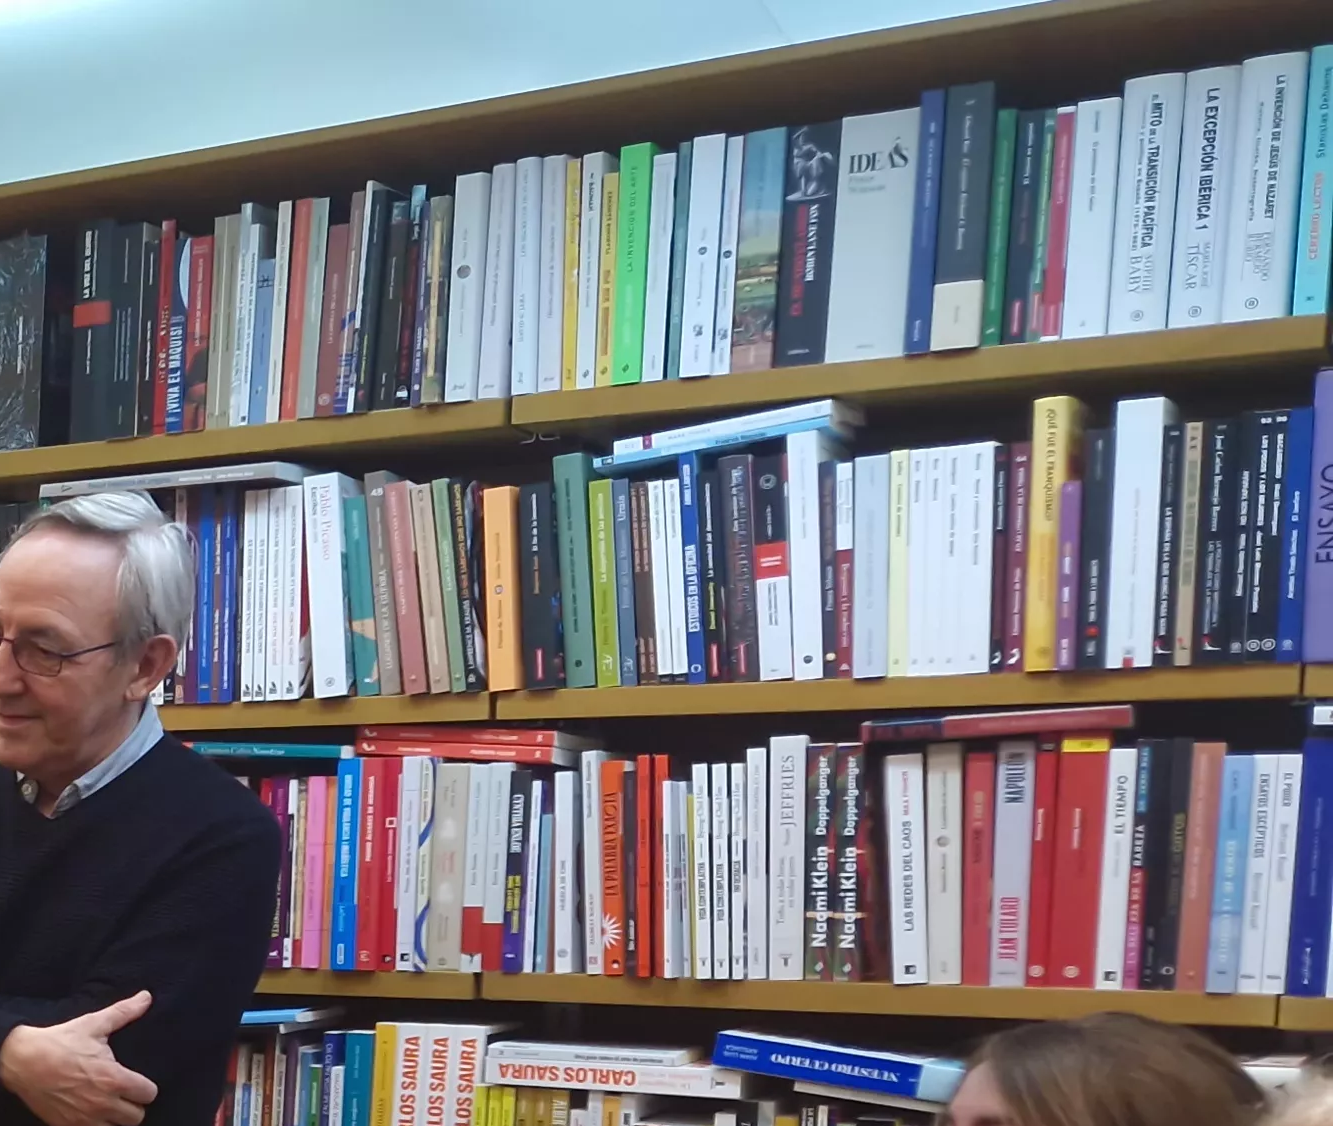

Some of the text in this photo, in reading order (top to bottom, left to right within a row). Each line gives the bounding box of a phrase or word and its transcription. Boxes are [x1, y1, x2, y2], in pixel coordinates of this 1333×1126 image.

[1205, 88, 1221, 104] LA
[1200, 106, 1219, 172] EXCEPCIÓN
[1141, 101, 1163, 248] MITO TRANSICIÓN PACÍFICA
[1196, 174, 1214, 221] IBÉRICA
[1128, 257, 1142, 293] BABY
[169, 367, 181, 380] EL
[1047, 432, 1057, 448] FUE
[1214, 452, 1223, 474] Carlos
[1215, 435, 1225, 450] José
[320, 485, 331, 560] Pablo Picasso
[1315, 464, 1333, 564] ENSAYO
[687, 596, 700, 632] ESTOICOS
[511, 794, 525, 827] CYNTHIA
[780, 756, 795, 826] JEFFRIES
[1114, 775, 1129, 835] EL TIEMPO
[1254, 774, 1271, 858] ENSAYOS ESCÉPTICOS
[603, 838, 618, 882] PALABRA
[810, 756, 831, 948] Naomi Klein Doppelganger
[839, 756, 860, 949] Naomi Klein Doppelganger
[903, 820, 915, 932] LAS REDES DEL CAOS
[605, 884, 619, 896] LA
[401, 1035, 421, 1093] SAURA
[430, 1037, 449, 1094] SAURA
[457, 1038, 477, 1094] SAURA
[498, 1063, 636, 1086] CARLOS SAURA
[770, 1052, 901, 1083] NUESTRO CUERPO
